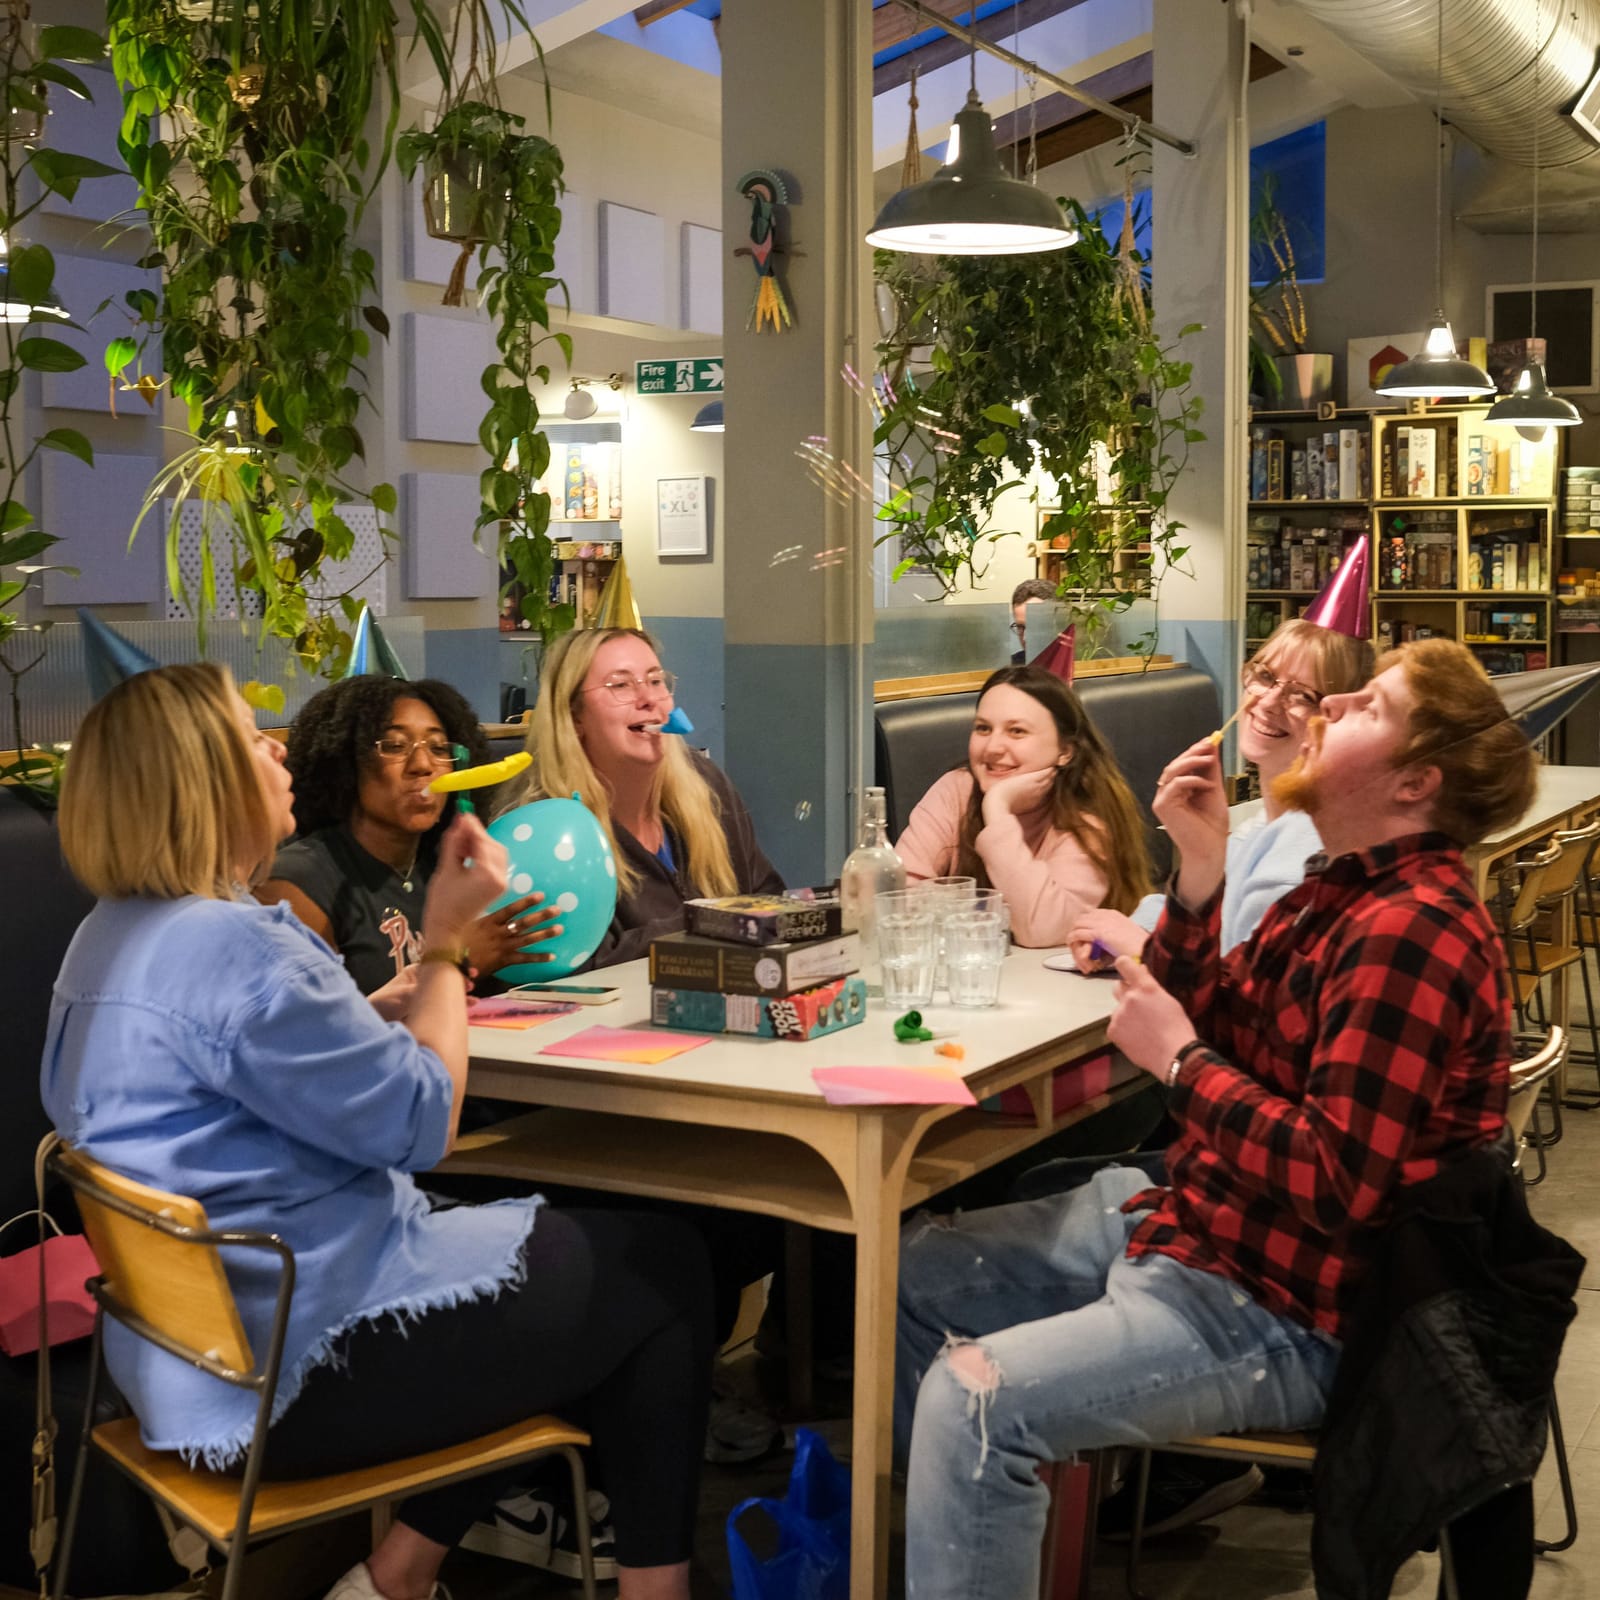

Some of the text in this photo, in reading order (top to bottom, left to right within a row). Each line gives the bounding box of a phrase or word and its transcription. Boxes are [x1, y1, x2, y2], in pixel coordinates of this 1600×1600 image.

[640, 364, 666, 376] Fire
[641, 378, 665, 391] exit
[1320, 403, 1333, 419] D
[1409, 398, 1420, 414] E
[670, 500, 689, 513] XL
[1027, 542, 1037, 557] 2
[769, 1001, 791, 1036] COOL
[780, 999, 804, 1033] STAY
